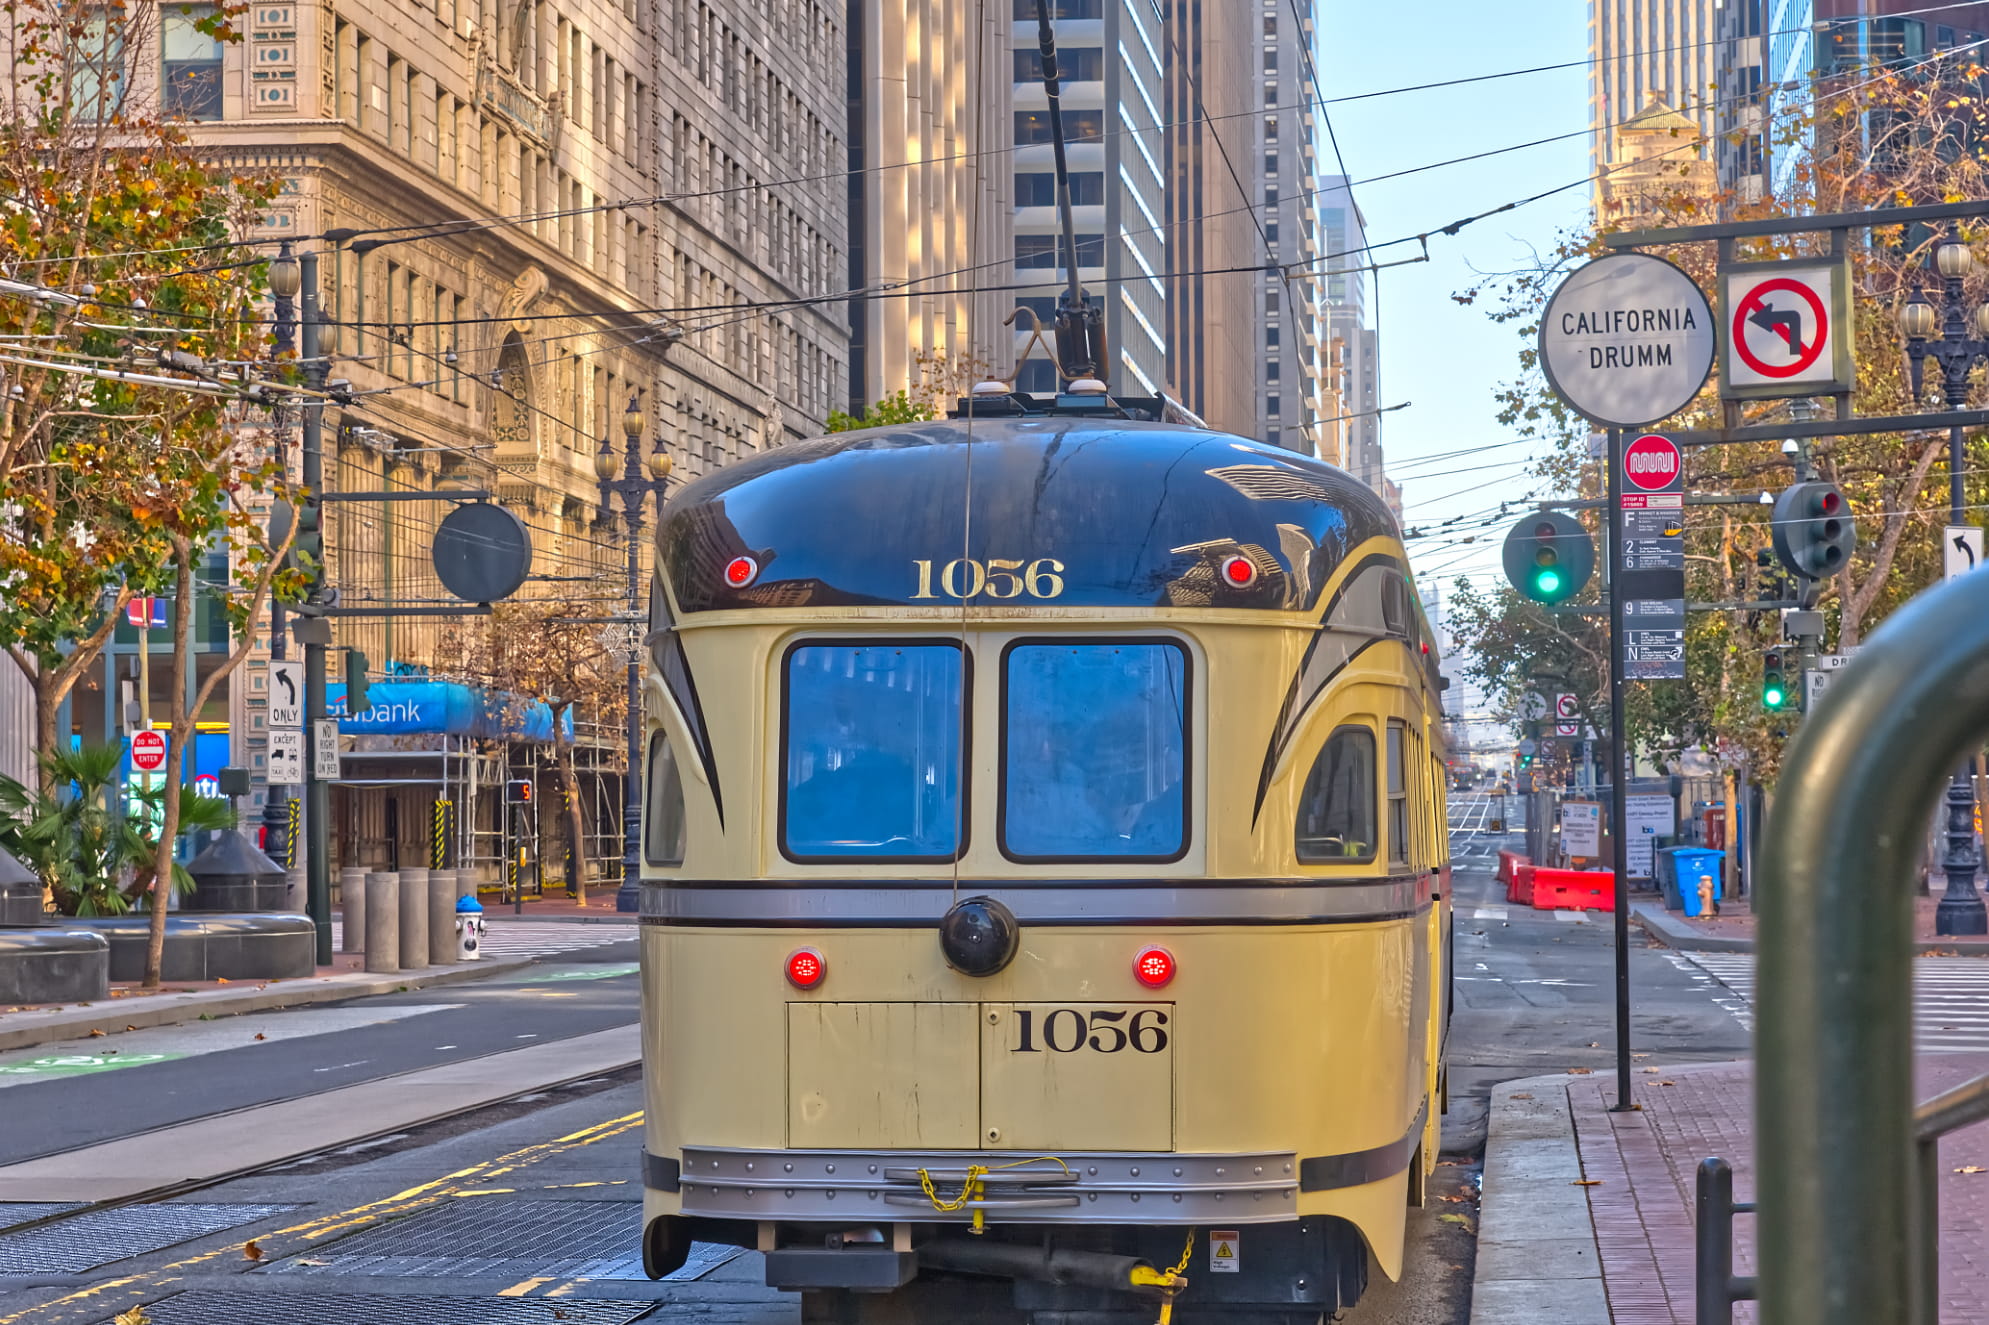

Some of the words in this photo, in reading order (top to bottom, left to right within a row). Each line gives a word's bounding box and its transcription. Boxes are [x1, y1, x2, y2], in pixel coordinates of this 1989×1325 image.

[1562, 308, 1697, 336] CALIFORNIA
[1590, 344, 1672, 369] DRUMM
[1629, 452, 1675, 474] MUNI
[1624, 511, 1635, 527] F
[1626, 540, 1634, 553] 2
[1626, 556, 1634, 569] 6
[908, 558, 1065, 599] 1056
[1625, 601, 1633, 615] 9
[1628, 631, 1637, 645] L
[1628, 647, 1638, 660] N
[1832, 658, 1848, 667] DR
[1814, 674, 1824, 688] NO
[273, 708, 298, 721] ONLY
[322, 726, 331, 738] NO
[273, 736, 296, 745] EXCEPT
[320, 740, 335, 750] RIGHT
[139, 755, 158, 763] ENTER
[320, 751, 334, 761] TURN
[317, 763, 326, 773] ON
[327, 763, 337, 774] RED
[523, 785, 530, 800] 5
[1010, 1009, 1169, 1054] 1056
